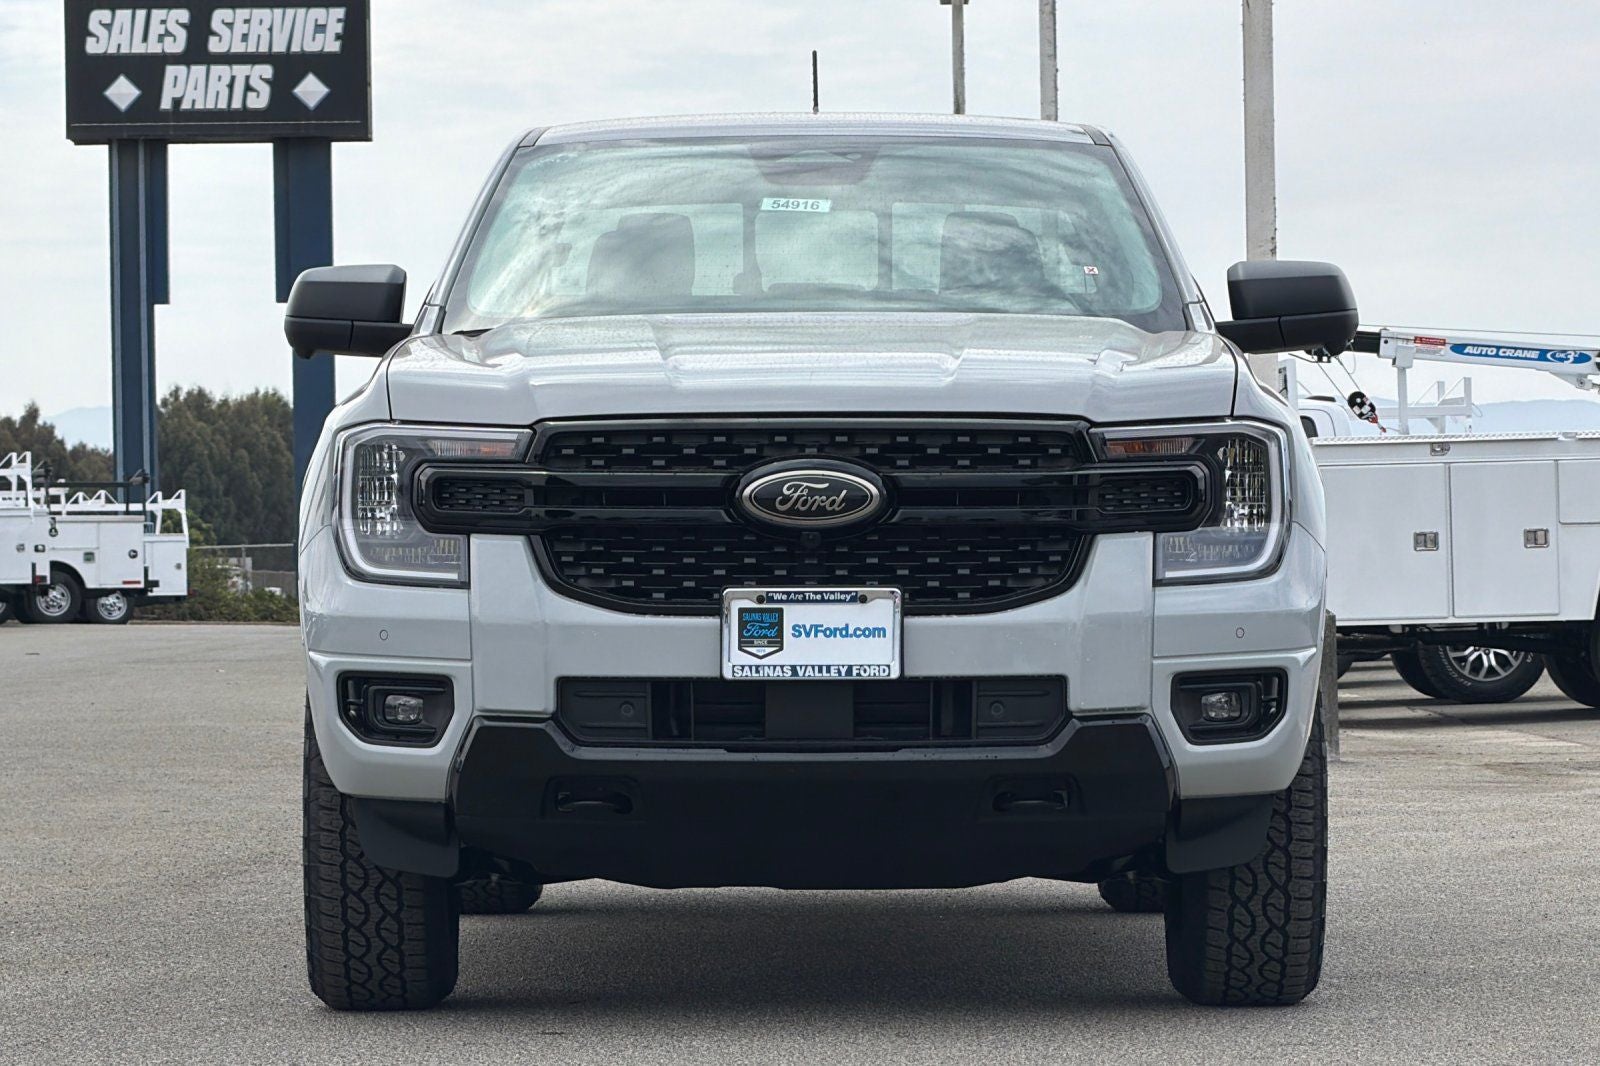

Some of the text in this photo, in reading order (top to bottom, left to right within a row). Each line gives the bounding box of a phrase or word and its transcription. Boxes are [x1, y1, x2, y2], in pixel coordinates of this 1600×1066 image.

[85, 7, 346, 54] SALES SERVICE
[159, 64, 274, 111] PARTS
[771, 199, 821, 210] 54916
[1464, 345, 1540, 359] AUTO CRANE
[775, 481, 849, 512] Ford
[788, 592, 804, 601] Are
[804, 592, 822, 600] The
[743, 622, 779, 637] Ford
[791, 623, 887, 639] SVFord.com
[733, 665, 890, 678] SALINAS VALLEY FORD
